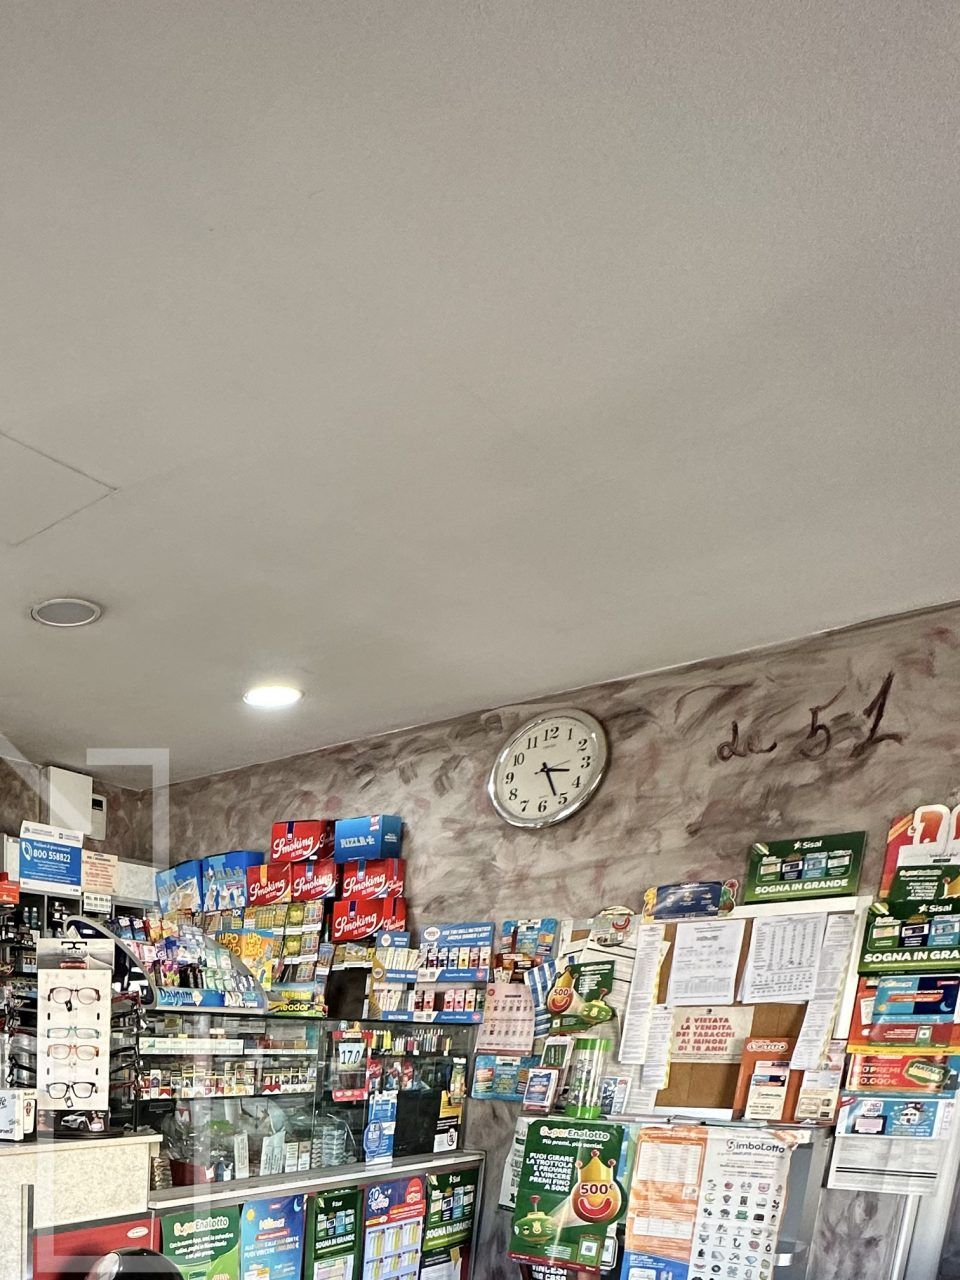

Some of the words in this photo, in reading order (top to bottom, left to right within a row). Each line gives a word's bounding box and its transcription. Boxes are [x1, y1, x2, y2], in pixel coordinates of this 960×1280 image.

[543, 726, 560, 742] 12
[567, 727, 573, 741] 1
[526, 736, 538, 750] 11
[577, 738, 588, 752] 2
[513, 752, 525, 767] 10
[580, 755, 591, 769] 3
[505, 771, 515, 785] 9
[571, 775, 581, 789] 4
[508, 788, 518, 801] 8
[557, 792, 569, 805] 5
[520, 799, 530, 813] 7
[537, 799, 548, 813] 6
[272, 834, 315, 859] Smoking
[803, 840, 823, 849] Sisal
[32, 849, 48, 859] 800
[48, 850, 71, 863] 558822
[249, 877, 286, 902] Smoking
[293, 873, 333, 899] Smoking
[342, 873, 386, 898] Smoking
[754, 884, 791, 895] SOGNA
[791, 882, 803, 891] IN
[804, 879, 849, 890] GRANDE
[928, 903, 953, 913] Sisal
[334, 913, 378, 938] Smoking
[863, 952, 912, 963] SOGNA
[912, 950, 928, 961] IN
[160, 987, 193, 1007] Daygum
[553, 988, 570, 996] 500
[539, 1125, 610, 1142] SuperEnalotto
[529, 1152, 547, 1160] PUOI
[547, 1154, 575, 1163] GIRARE
[536, 1159, 574, 1169] TROTTOLA
[539, 1165, 573, 1175] PROVARE
[540, 1171, 572, 1181] VINCERE
[528, 1176, 552, 1184] PREMI
[552, 1178, 571, 1186] FINO
[551, 1184, 570, 1193] 500€
[173, 1215, 229, 1237] SuperEnalotto
[425, 1225, 447, 1240] SOGNA
[446, 1225, 454, 1234] IN
[315, 1238, 333, 1249] SOGNA
[336, 1233, 356, 1244] GRANDE
